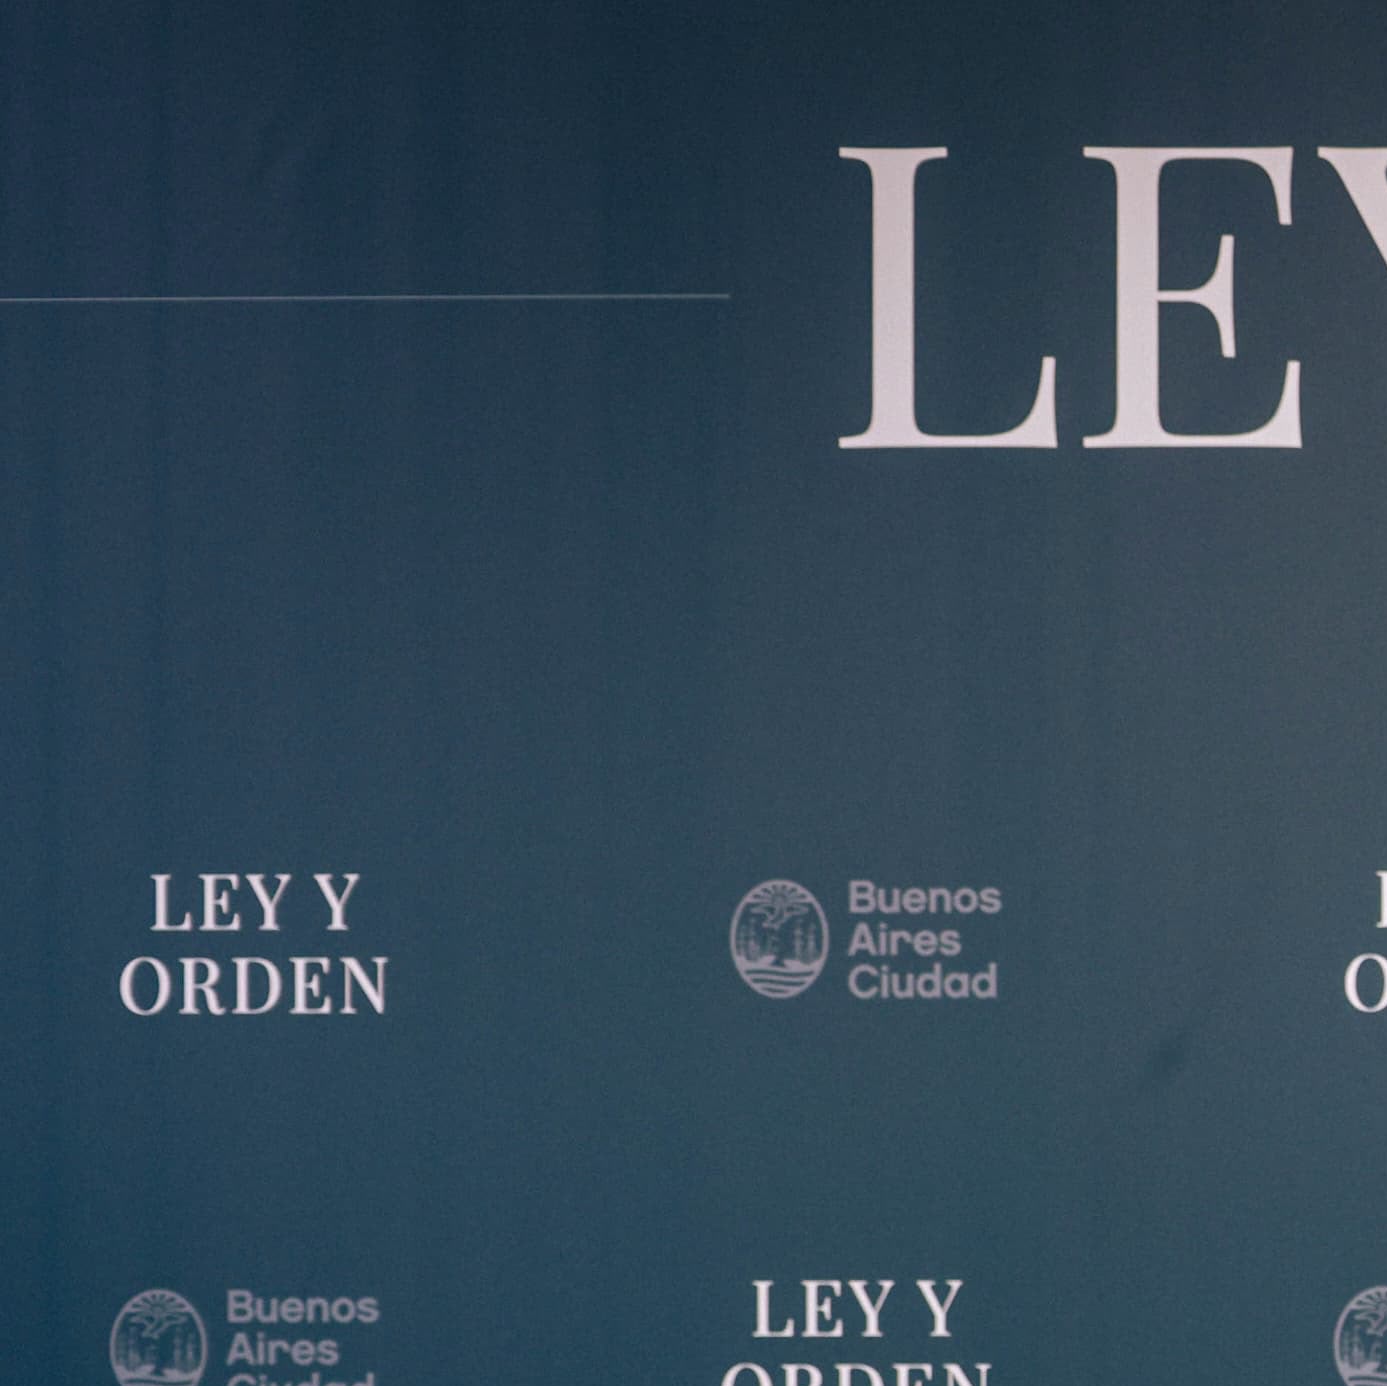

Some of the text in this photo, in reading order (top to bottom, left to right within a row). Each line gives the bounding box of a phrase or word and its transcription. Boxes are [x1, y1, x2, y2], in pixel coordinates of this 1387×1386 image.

[150, 873, 360, 932] LEY Y
[849, 880, 1002, 914] Buenos
[848, 922, 962, 956] Aires
[119, 956, 389, 1016] ORDEN
[848, 962, 997, 999] Ciudad
[227, 1289, 380, 1323] Buenos
[752, 1279, 964, 1338] LEY Y
[227, 1332, 340, 1365] Aires
